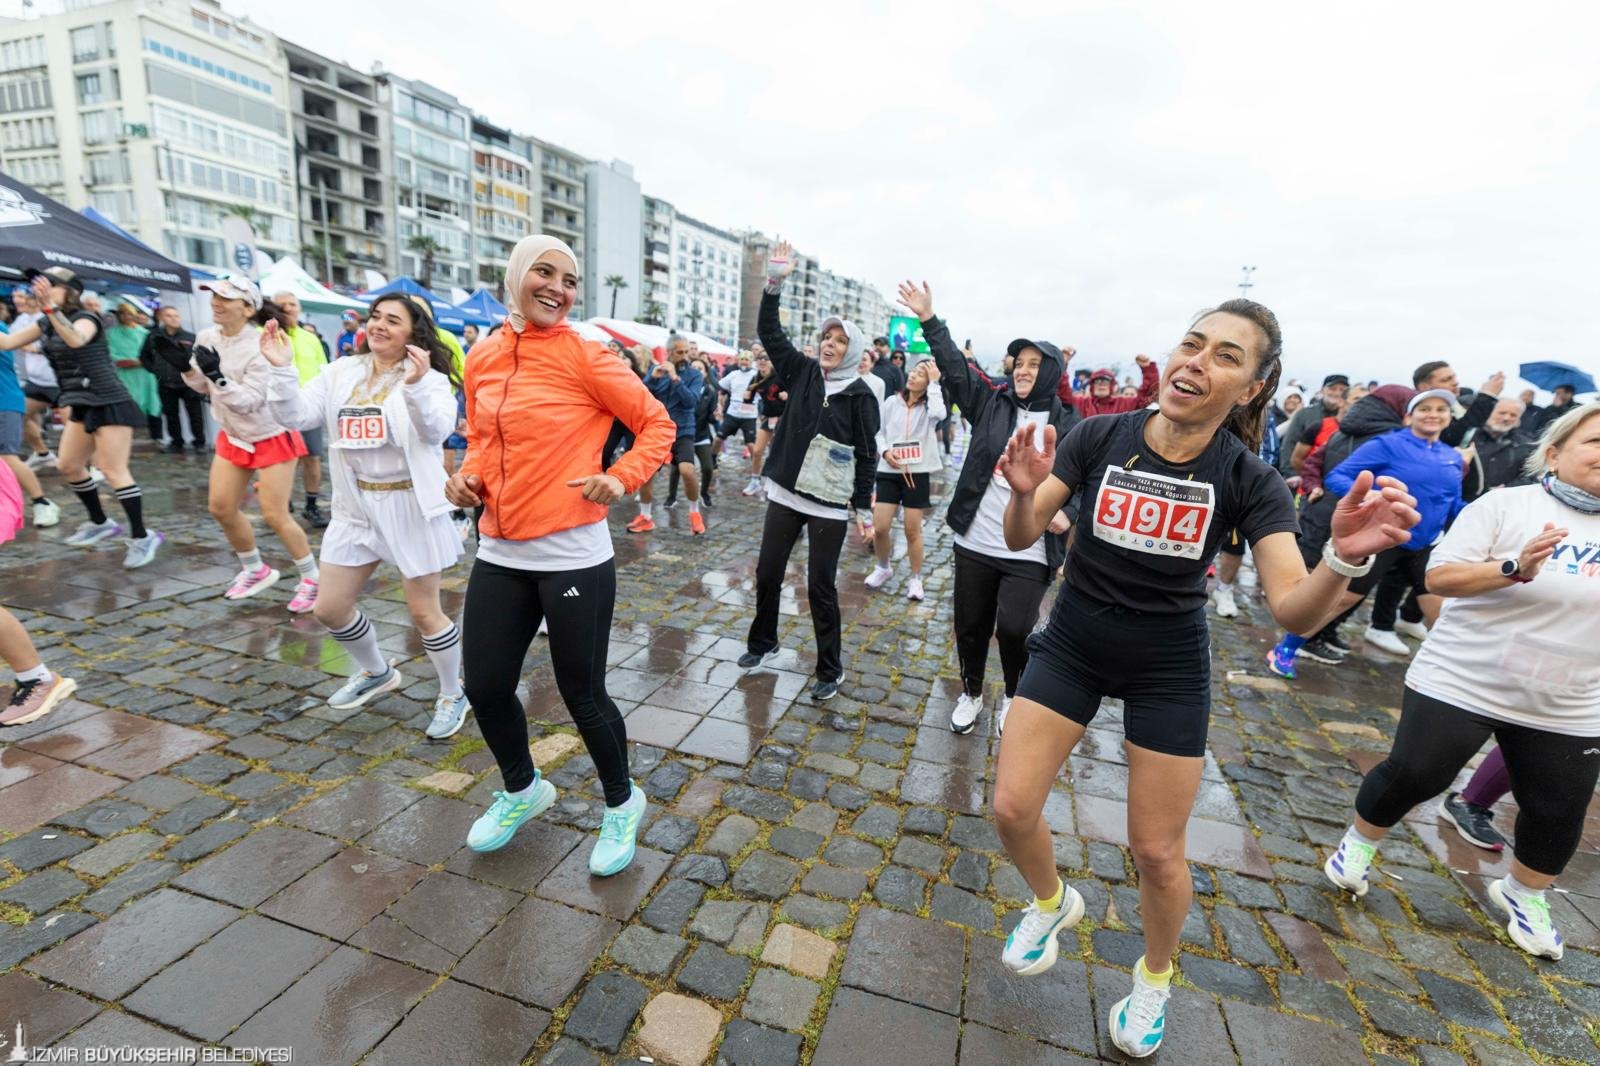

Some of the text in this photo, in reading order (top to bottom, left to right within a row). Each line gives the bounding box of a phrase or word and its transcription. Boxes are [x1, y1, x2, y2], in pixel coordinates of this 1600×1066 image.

[1137, 478, 1177, 491] YAZA MERHABA
[1138, 484, 1162, 495] DOSTLUK
[1102, 492, 1199, 540] 394
